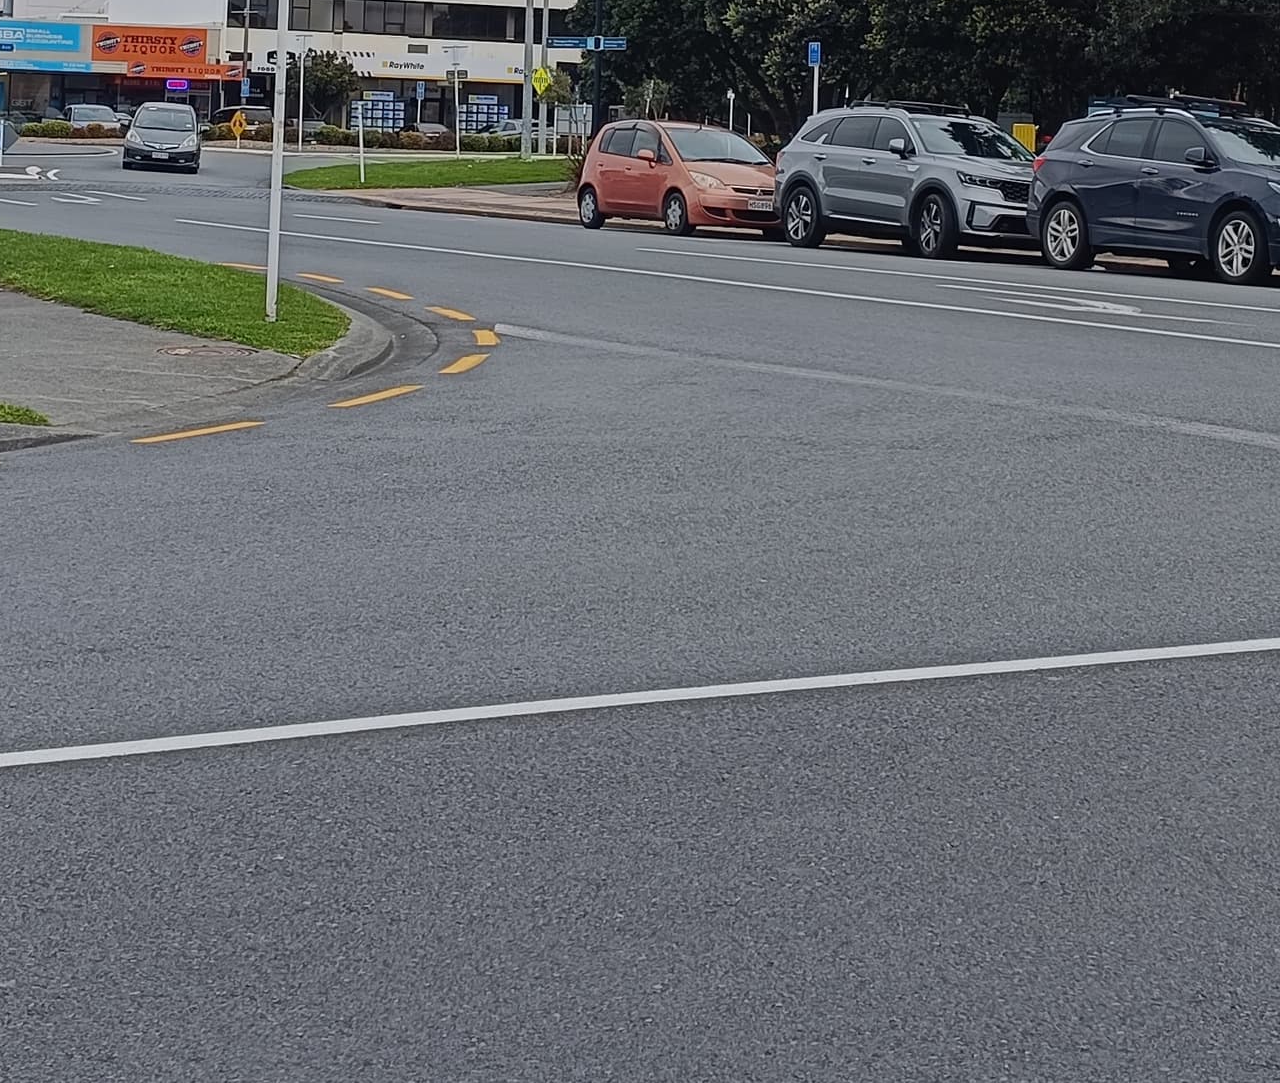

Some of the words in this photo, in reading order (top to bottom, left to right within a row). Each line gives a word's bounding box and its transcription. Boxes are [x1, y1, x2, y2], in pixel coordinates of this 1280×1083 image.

[122, 35, 177, 45] THIRSTY
[123, 44, 177, 55] LIQUOR
[388, 61, 425, 70] RayWhite
